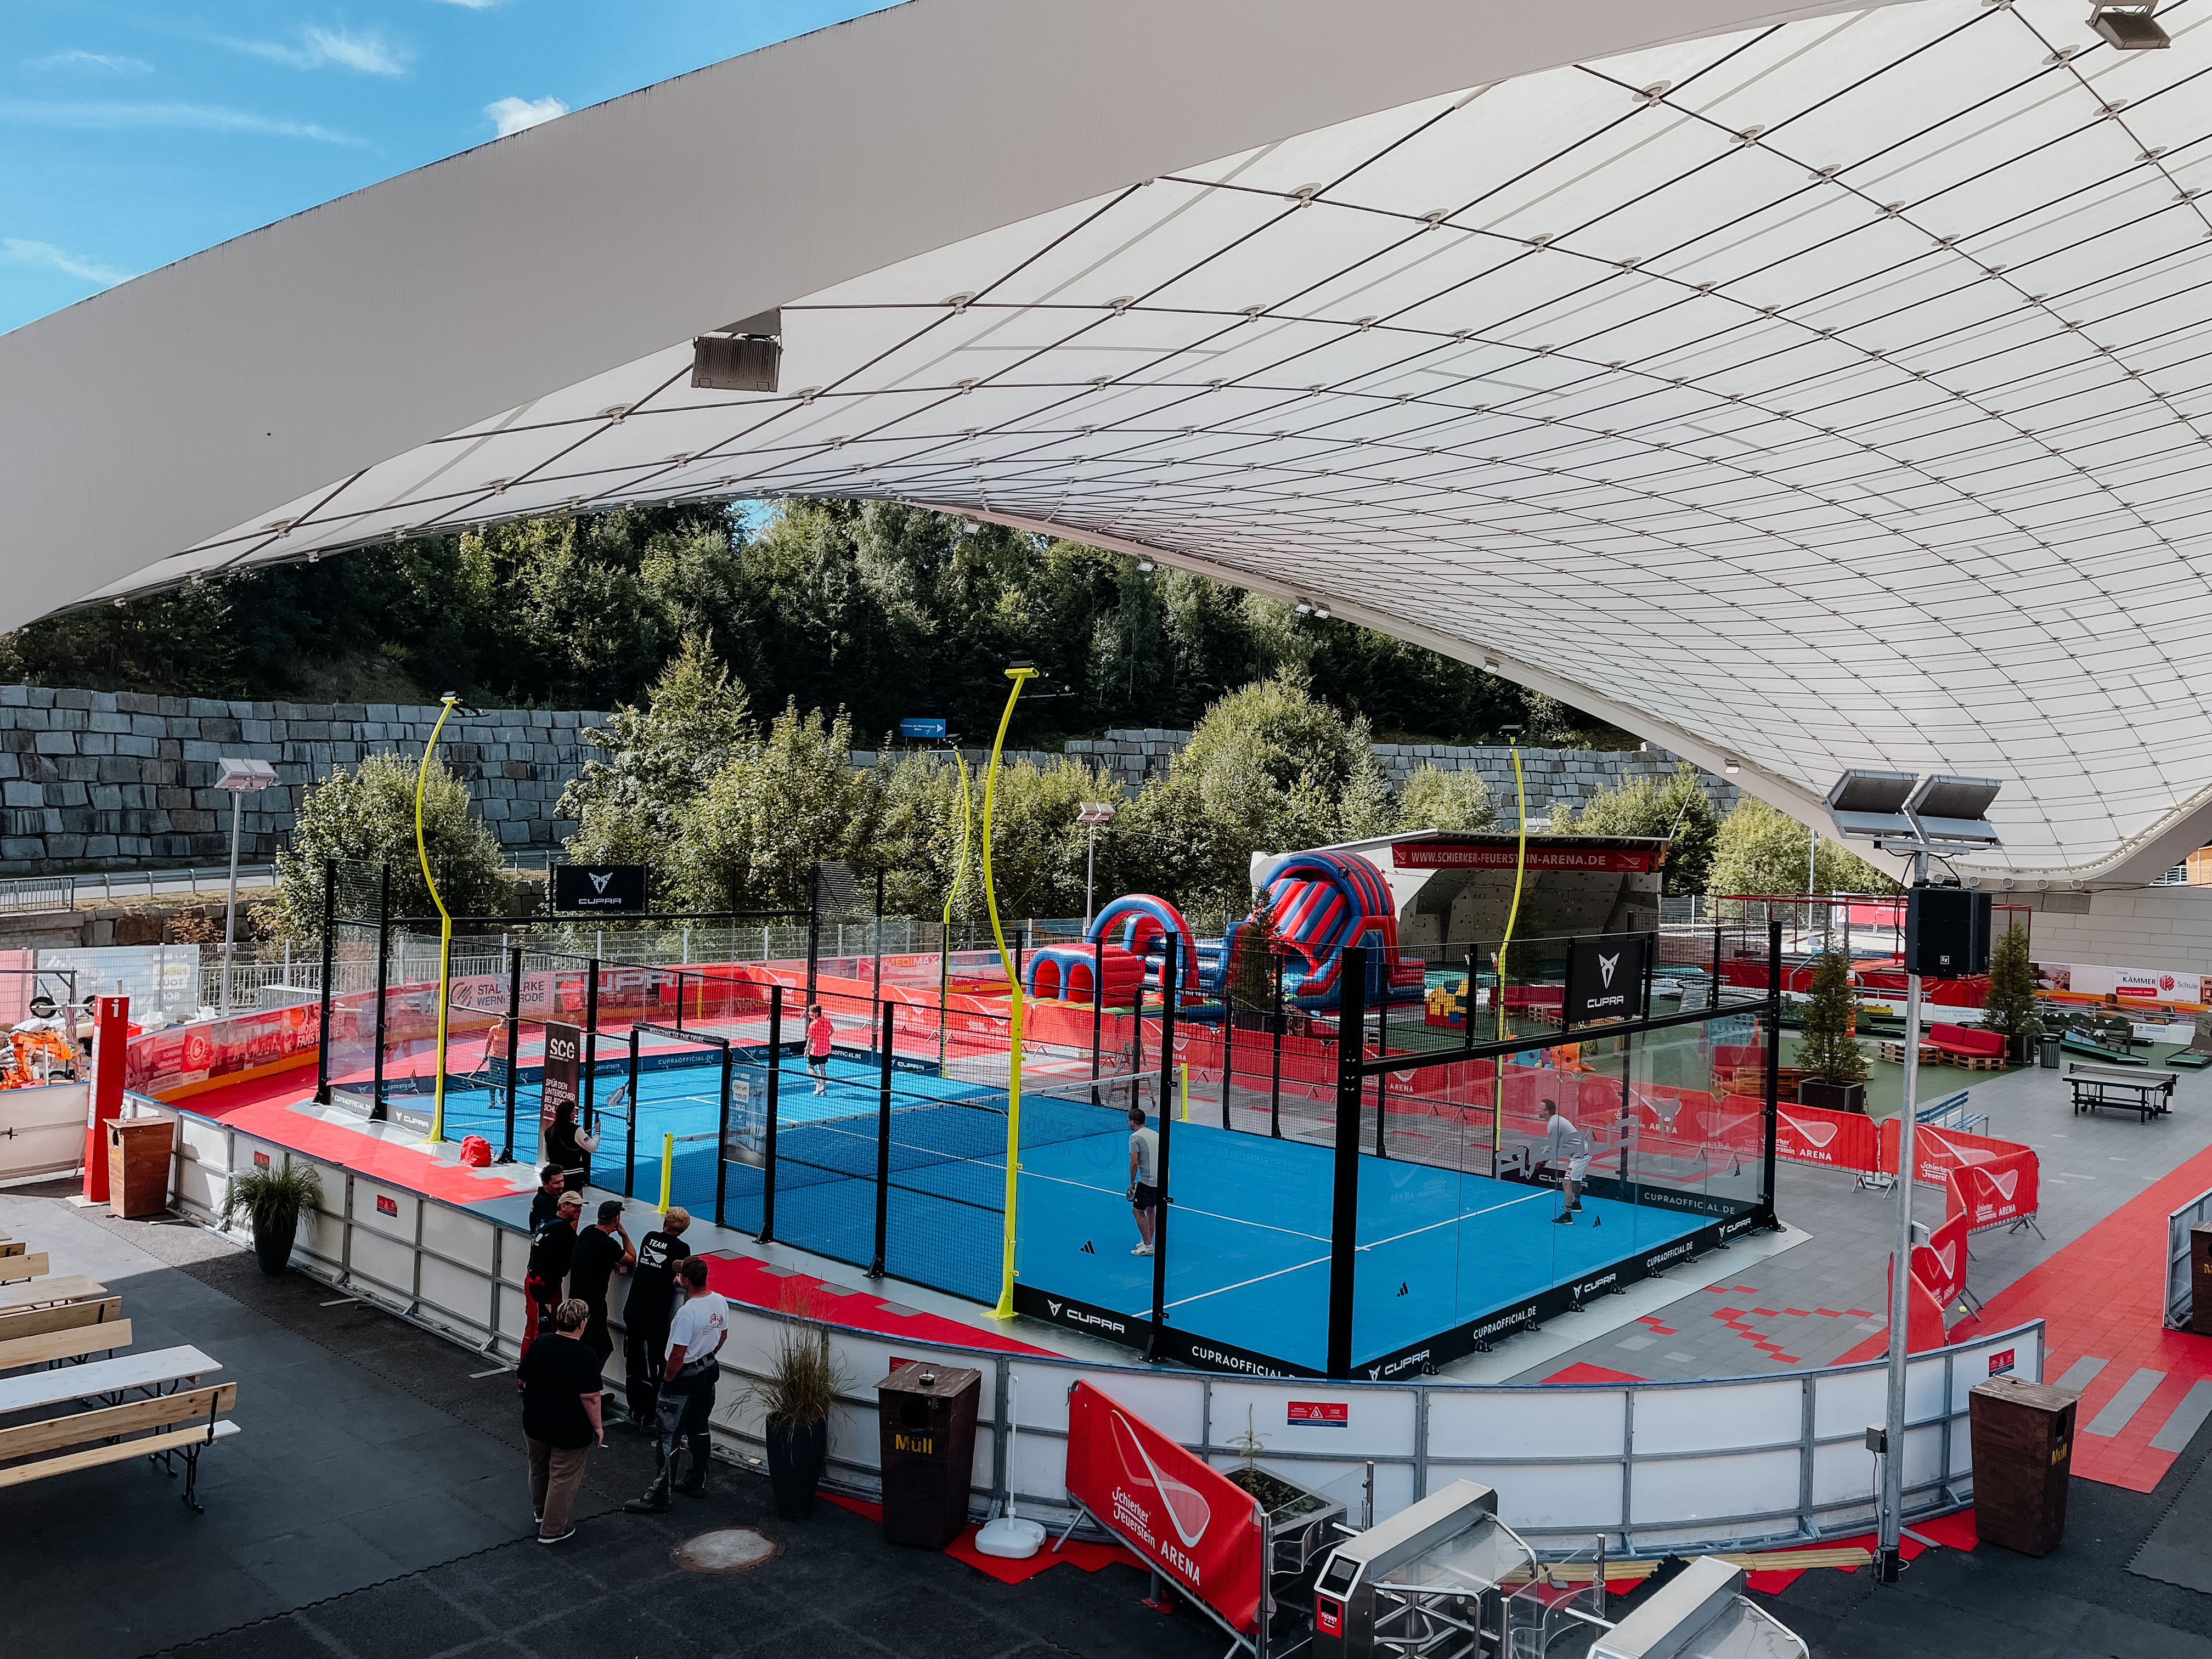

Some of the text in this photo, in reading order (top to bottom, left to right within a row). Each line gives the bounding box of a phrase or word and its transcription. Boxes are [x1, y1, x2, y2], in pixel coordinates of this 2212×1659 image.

[1412, 851, 1606, 866] WWW.SCHIERKER-FEUERSTIN-ARENA.DE
[885, 956, 938, 967] MEDIMAX
[2123, 975, 2157, 985] KÄMMER
[2177, 981, 2199, 990] Schule
[1587, 995, 1624, 1009] CUPRA
[649, 1026, 672, 1037] WELCOME
[690, 1034, 706, 1043] TRIBE
[658, 1054, 714, 1065] CUPRAOFFICIAL.DE
[1173, 1053, 1187, 1061] RENA
[897, 1061, 924, 1071] CUPRA
[545, 1077, 568, 1091] SPÜR DEN
[1390, 1084, 1414, 1093] ARENA
[544, 1095, 552, 1104] BEI
[545, 1087, 575, 1101] UNTERSCHIED
[735, 1092, 748, 1101] TOUR
[334, 1094, 371, 1112] CUPRAOFFICIAL.DE
[403, 1115, 429, 1128] CUPRA
[1799, 1148, 1832, 1161] ARENA
[1644, 1192, 1736, 1215] CUPRAOFFICAL.DE
[1975, 1203, 1993, 1214] Schierker
[1998, 1204, 2016, 1217] ARENA
[1726, 1217, 1751, 1233] CUPRA
[649, 1238, 668, 1250] TEAM
[1646, 1241, 1694, 1268] CUPRAOFFICIAL.DE
[1583, 1273, 1616, 1293] CUPRA
[1066, 1309, 1125, 1334] CUPRA
[1473, 1306, 1537, 1340] CUPRAOFFICIAL.DE
[1384, 1349, 1430, 1376] CUPRA
[895, 1434, 933, 1454] Müll
[1112, 1486, 1149, 1523] Schierker
[1113, 1502, 1201, 1587] Feuerstein ARENA
[1321, 1612, 1338, 1623] TICKET
